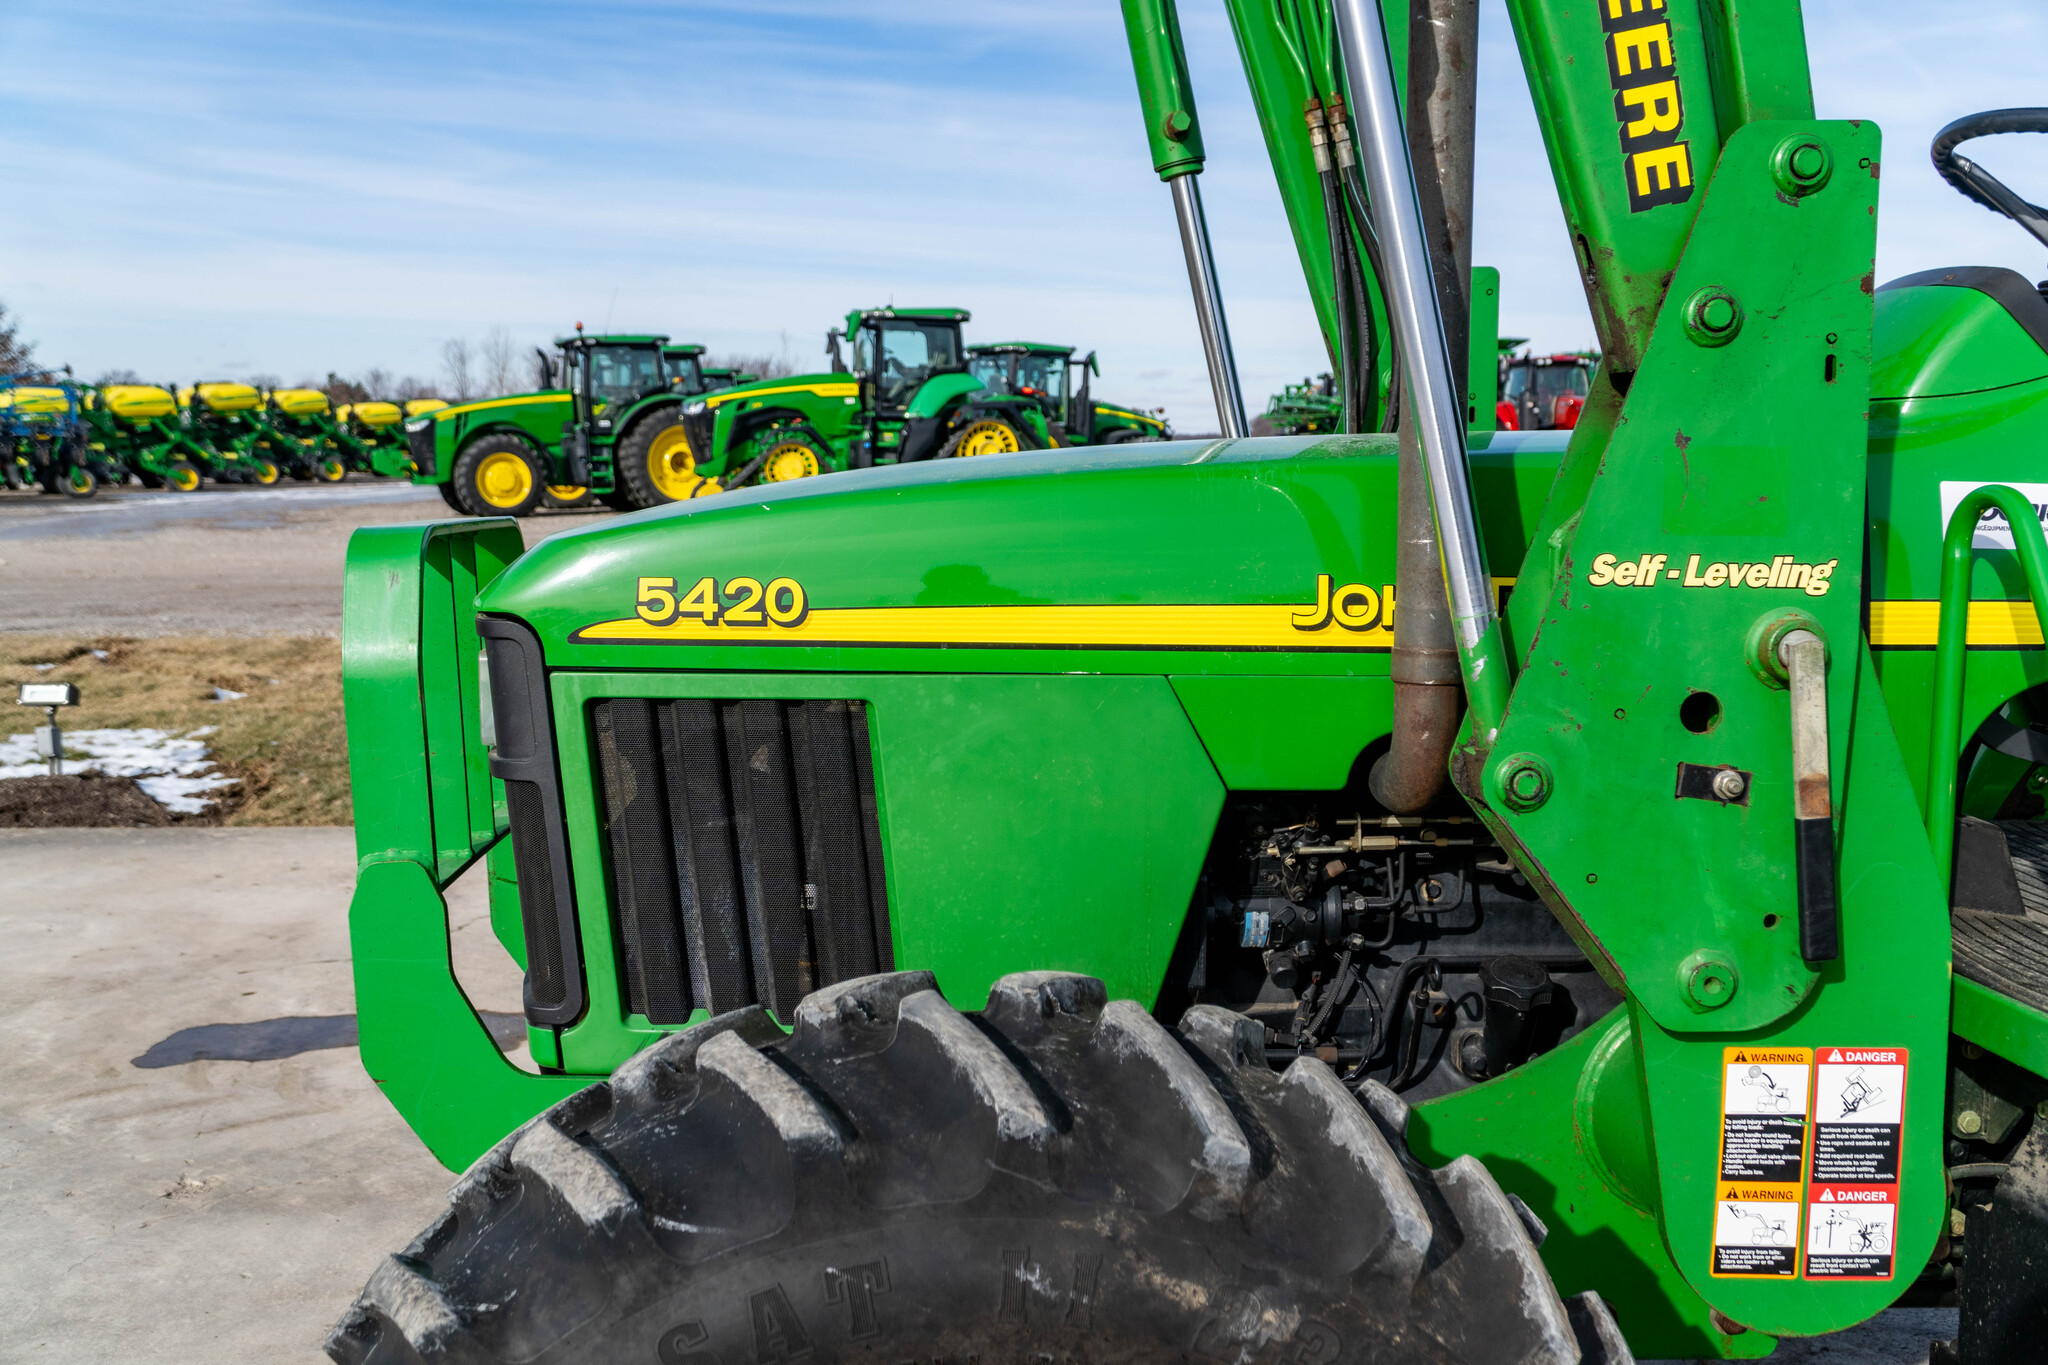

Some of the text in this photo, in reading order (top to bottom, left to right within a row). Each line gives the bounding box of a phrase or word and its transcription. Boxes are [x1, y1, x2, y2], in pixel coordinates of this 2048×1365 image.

[635, 576, 809, 628] 5420
[1292, 574, 1397, 631] JO
[1751, 1054, 1803, 1062] WARNING
[1846, 1052, 1896, 1062] DANGER
[1742, 1190, 1793, 1200] WARNING
[1837, 1191, 1887, 1201] DANGER
